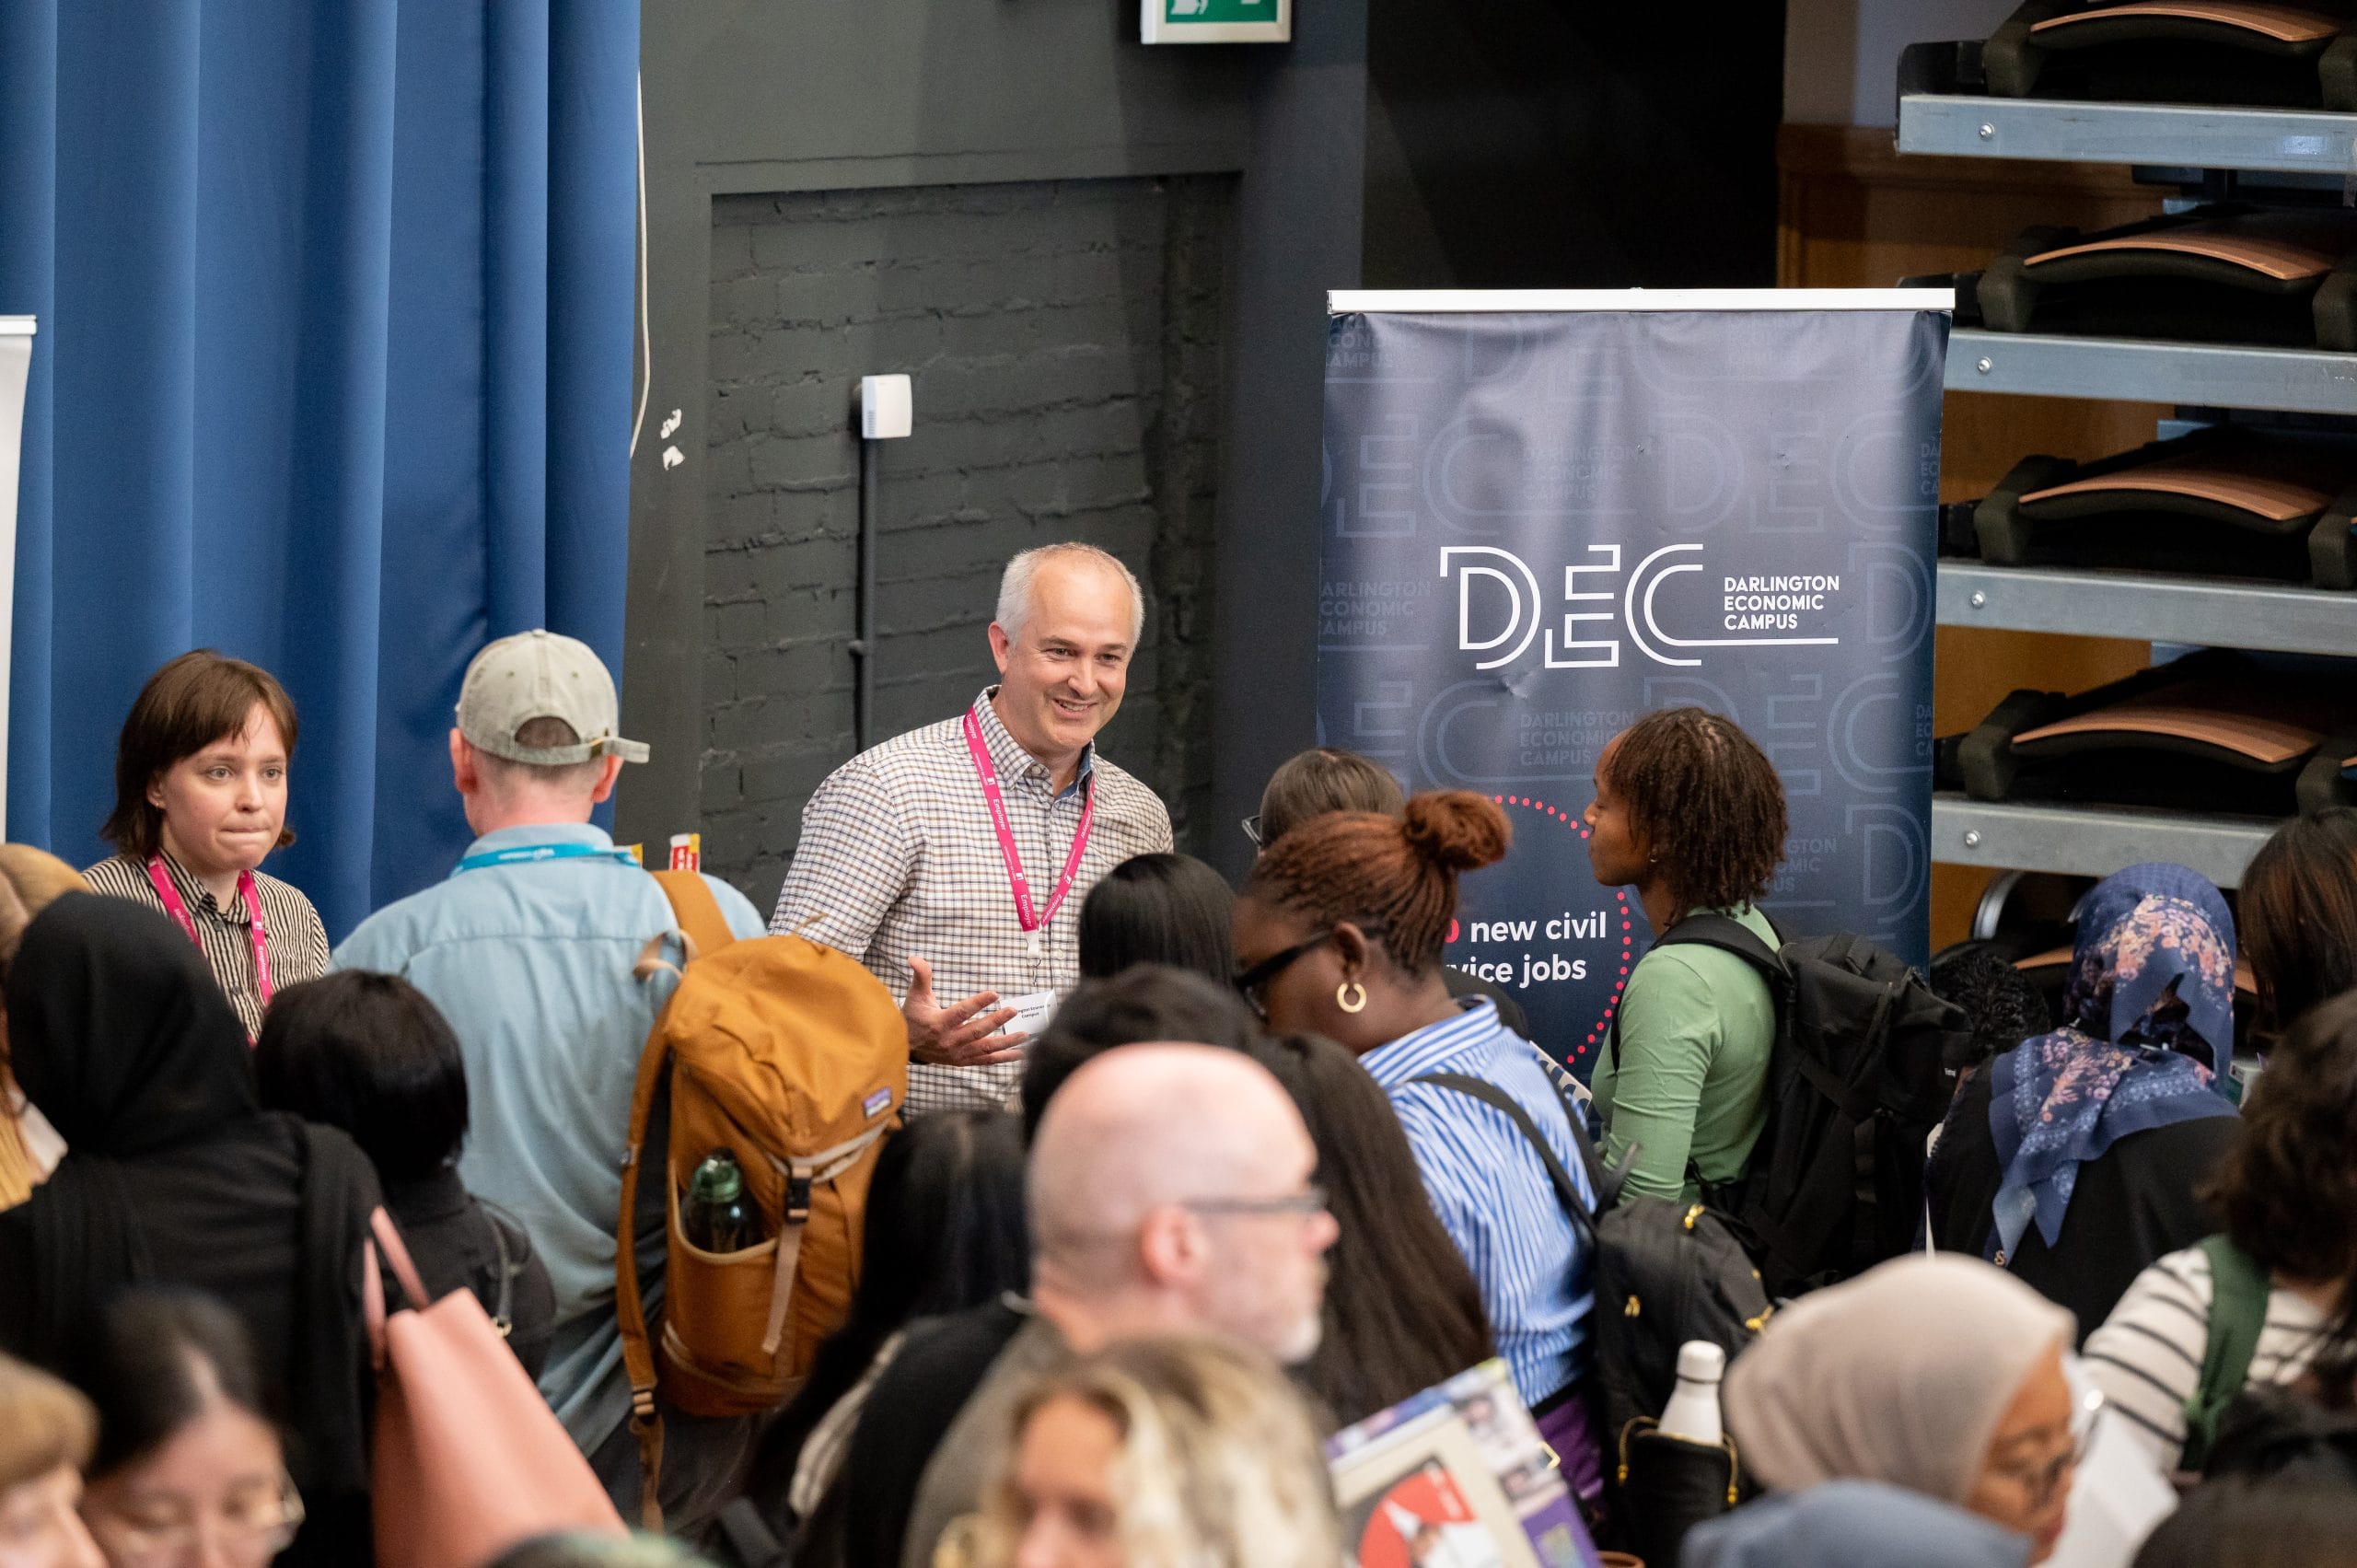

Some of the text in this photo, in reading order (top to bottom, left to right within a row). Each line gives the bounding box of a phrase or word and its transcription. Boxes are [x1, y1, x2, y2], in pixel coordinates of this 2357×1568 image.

[1320, 581, 1431, 598] ARLINGTON
[1724, 575, 1840, 593] DARLINGTON
[1319, 600, 1414, 616] CONOMIC
[1439, 544, 1703, 670] DEC
[1724, 594, 1825, 611] ECONOMIC
[1318, 620, 1387, 635] AMPUS
[1724, 613, 1798, 631] CAMPUS
[1520, 710, 1636, 727] DARLINGTON
[1520, 749, 1592, 766] CAMPUS
[993, 798, 1006, 830] Employer
[1020, 894, 1032, 927] Employer
[1470, 920, 1538, 943] new
[1545, 911, 1607, 940] civil
[1518, 953, 1586, 990] jobs
